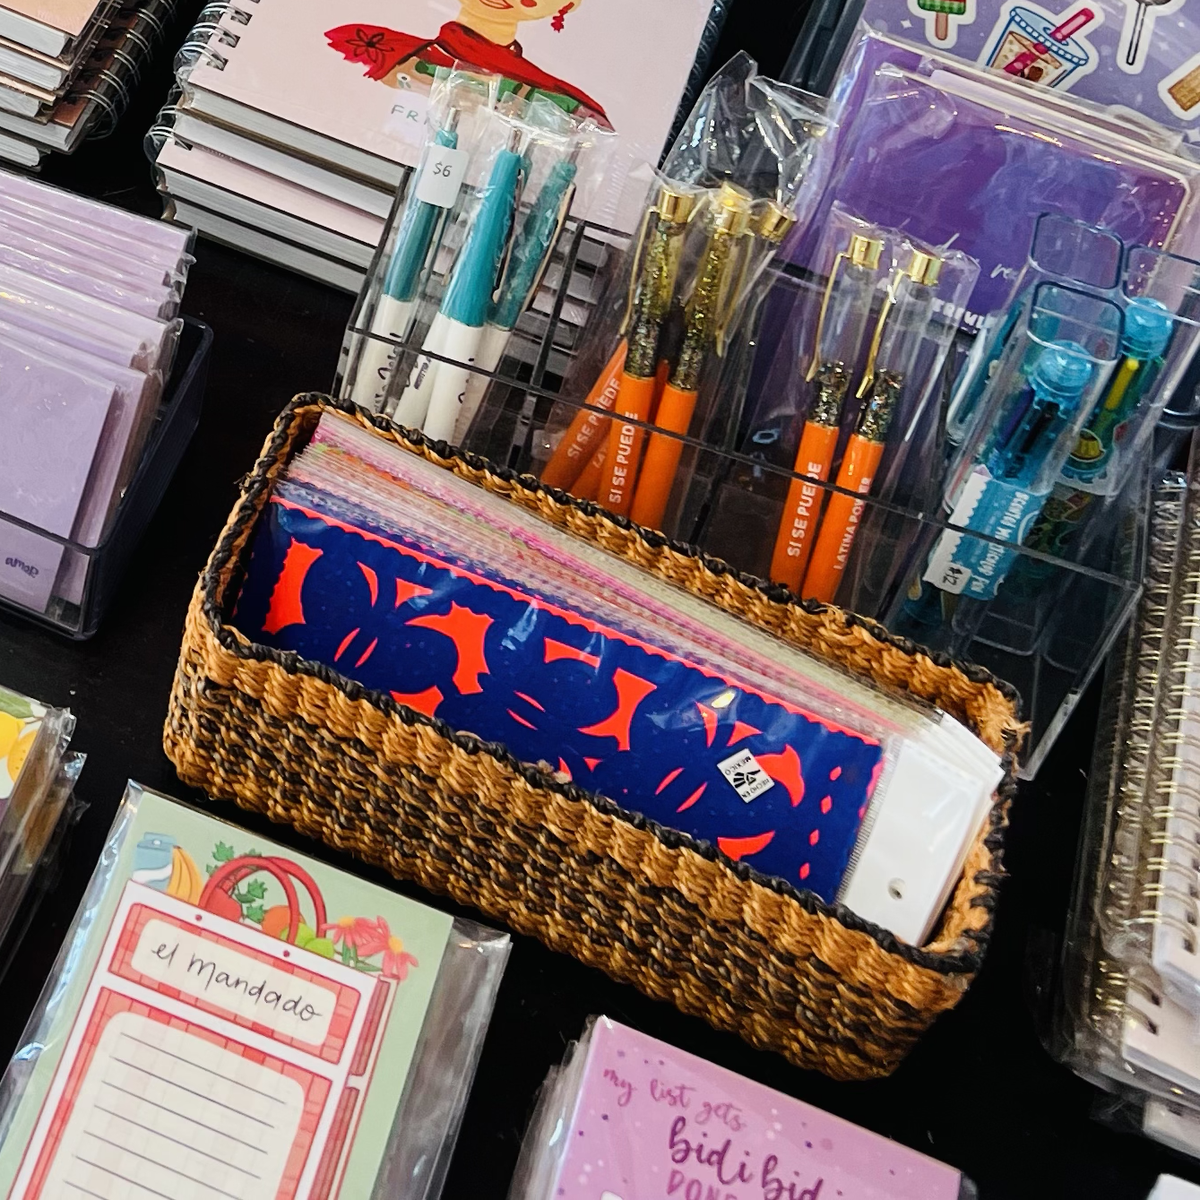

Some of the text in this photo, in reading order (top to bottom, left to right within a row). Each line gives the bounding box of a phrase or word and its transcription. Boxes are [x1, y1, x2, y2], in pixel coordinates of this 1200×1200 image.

[432, 161, 452, 178] $6
[567, 443, 583, 459] SI
[576, 424, 596, 445] SE
[612, 465, 628, 489] SE
[609, 490, 622, 504] SI
[792, 515, 808, 541] SE
[787, 539, 802, 558] SI
[833, 522, 856, 570] LATINA
[152, 943, 180, 965] el
[650, 1078, 696, 1108] list
[695, 1101, 748, 1132] gets
[669, 1115, 754, 1185] bidi
